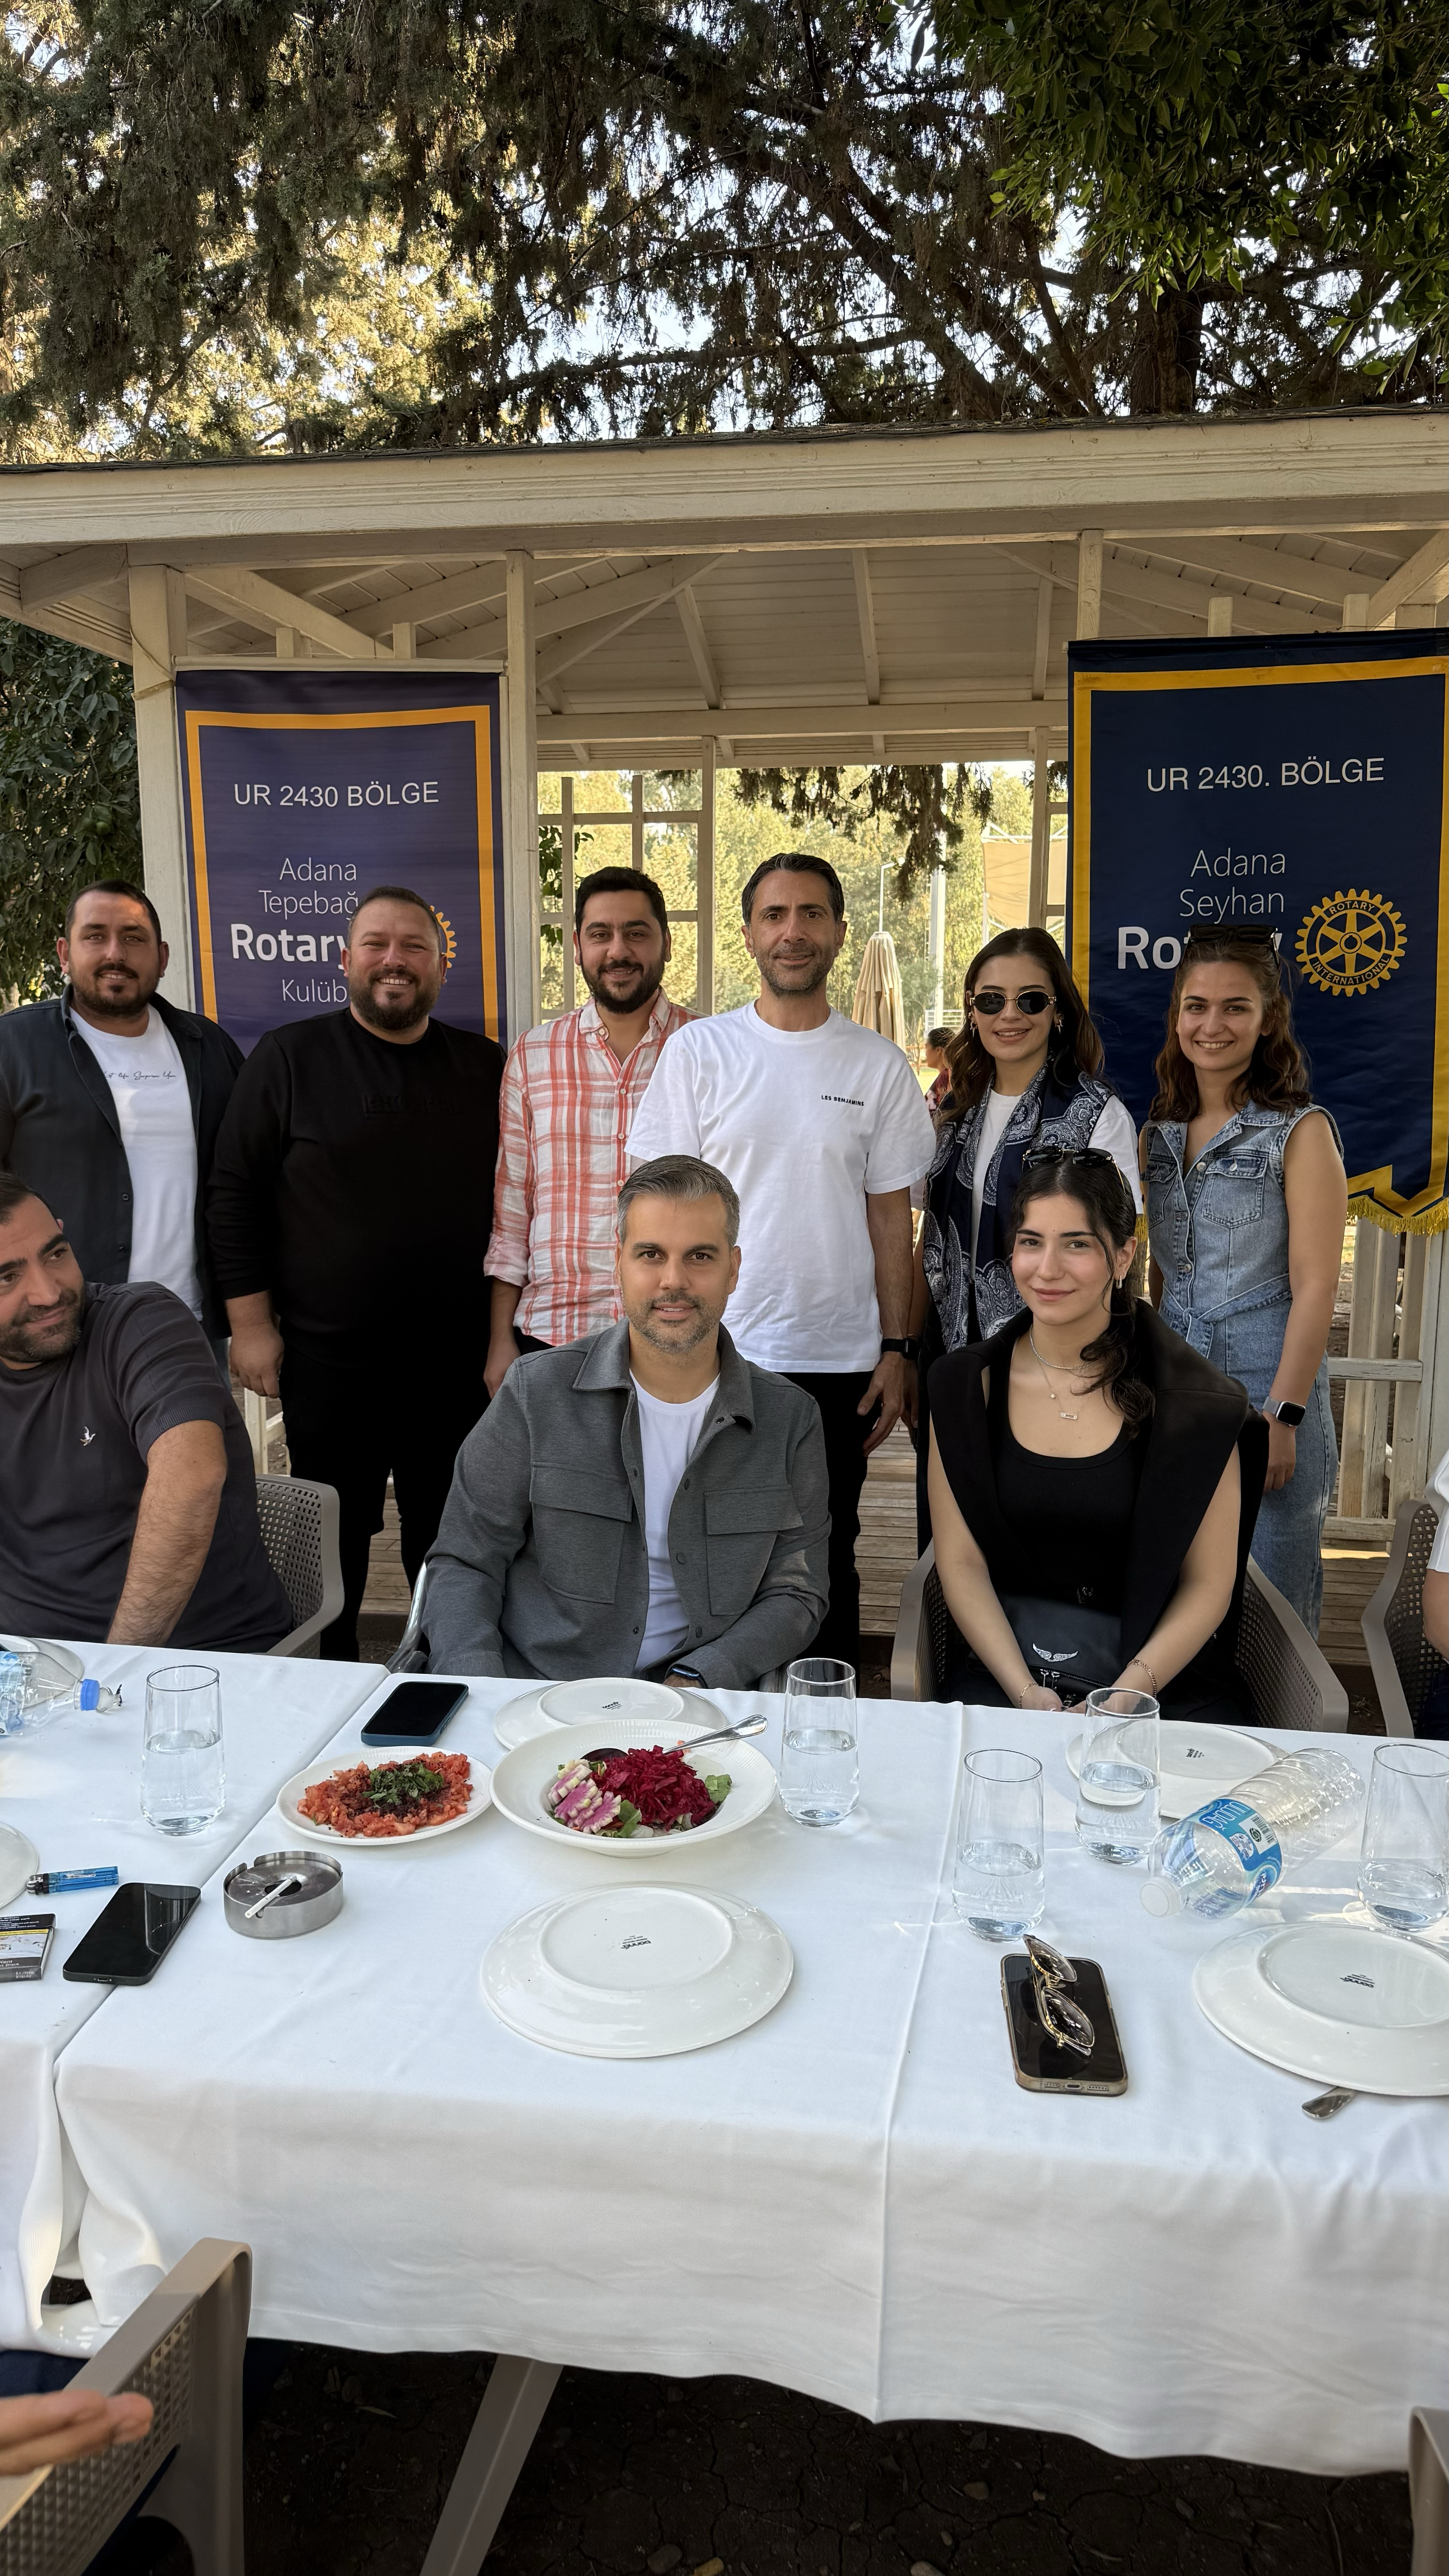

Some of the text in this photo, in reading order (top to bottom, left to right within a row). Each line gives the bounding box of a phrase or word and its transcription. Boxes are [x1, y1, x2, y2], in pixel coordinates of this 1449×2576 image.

[1147, 756, 1385, 792] UR 2430. BÖLGE
[234, 781, 439, 807] UR 2430 BÖLGE
[279, 857, 357, 881] Adana
[1190, 847, 1285, 878] Adana
[258, 890, 359, 920] Tepebağ
[1179, 886, 1284, 924] Seyhan
[1329, 901, 1375, 915] ROTARY
[1312, 957, 1390, 985] INTERNATIONAL
[282, 979, 347, 1003] Kulüb
[833, 1096, 865, 1106] BENJAMINS
